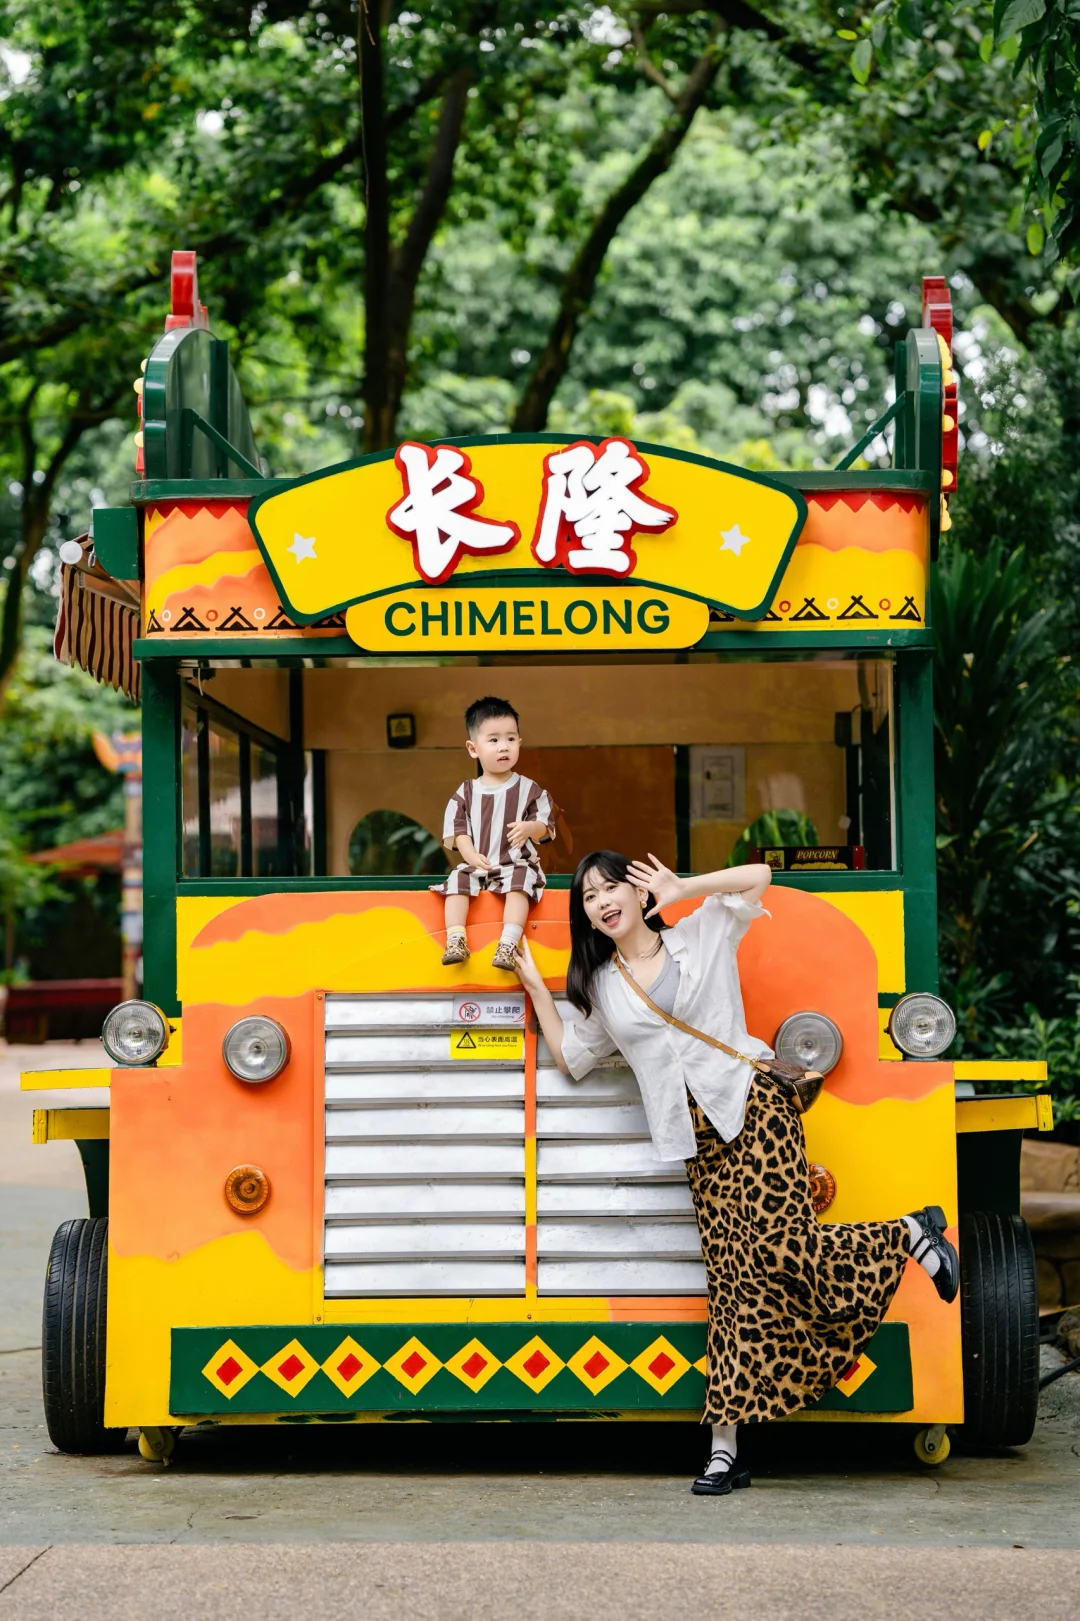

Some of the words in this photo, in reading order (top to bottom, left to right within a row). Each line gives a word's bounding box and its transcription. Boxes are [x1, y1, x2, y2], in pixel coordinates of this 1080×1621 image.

[388, 439, 676, 581] 长隆
[384, 599, 671, 637] CHIMELONG
[796, 849, 839, 859] POPCORN
